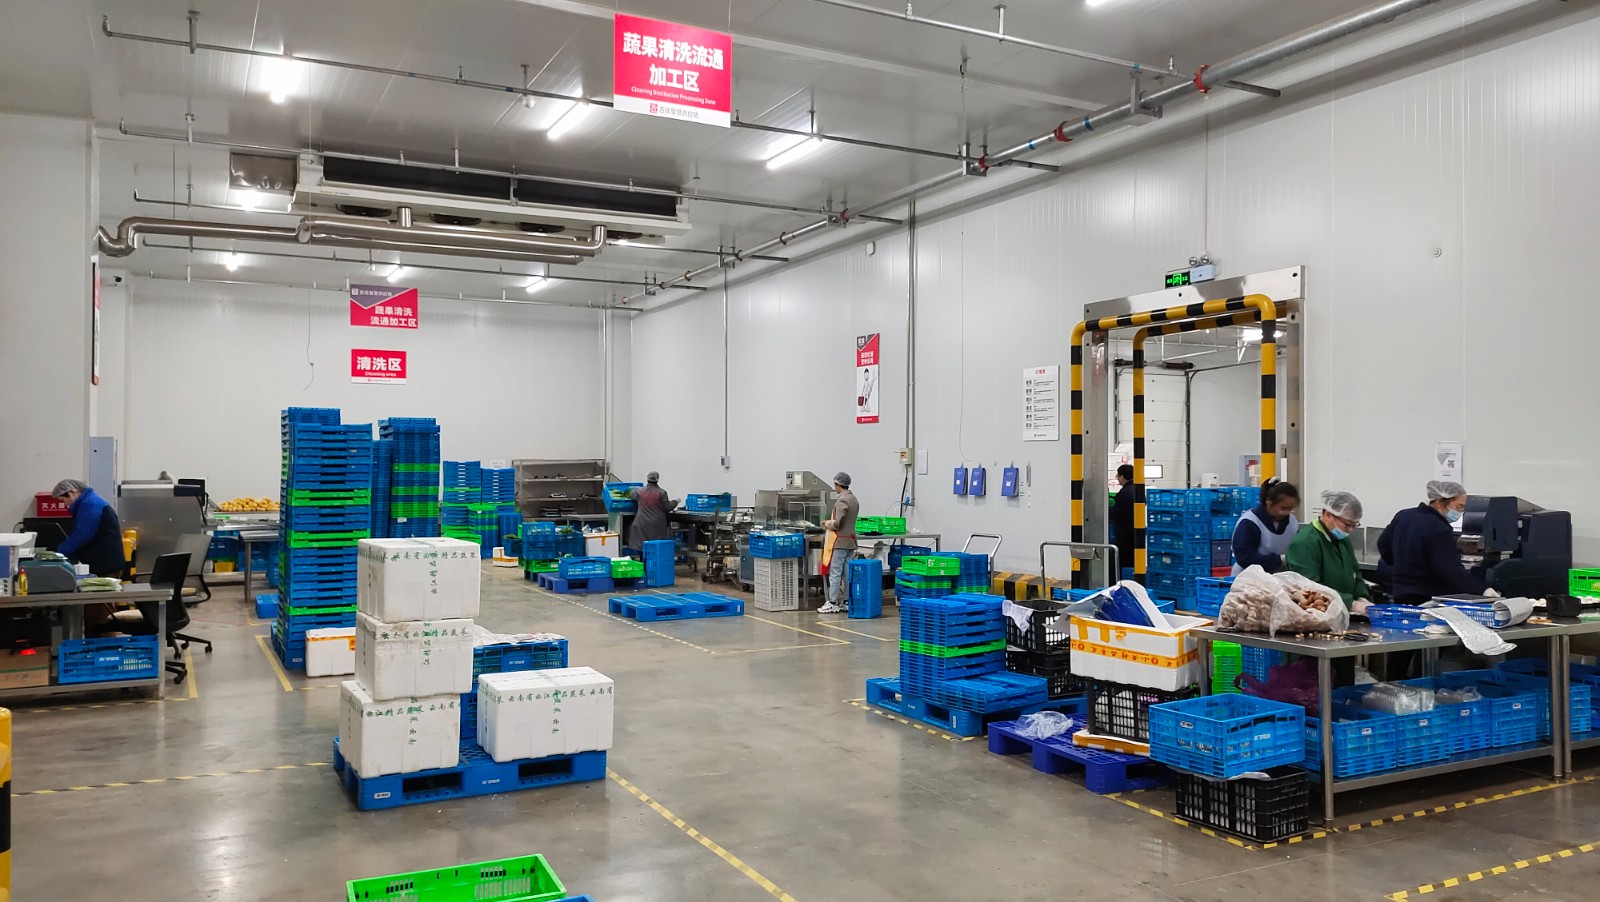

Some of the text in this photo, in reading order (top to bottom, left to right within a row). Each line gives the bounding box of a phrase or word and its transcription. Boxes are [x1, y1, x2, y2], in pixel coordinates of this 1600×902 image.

[623, 31, 724, 70] 蔬果清洗流通
[649, 63, 700, 93] 加工区
[631, 86, 653, 96] Cleaning
[679, 93, 704, 105] Processing
[704, 98, 716, 106] Zone
[375, 305, 413, 317] 蔬果清洗
[370, 316, 417, 328] 流通加工区
[356, 355, 402, 372] 清洗区
